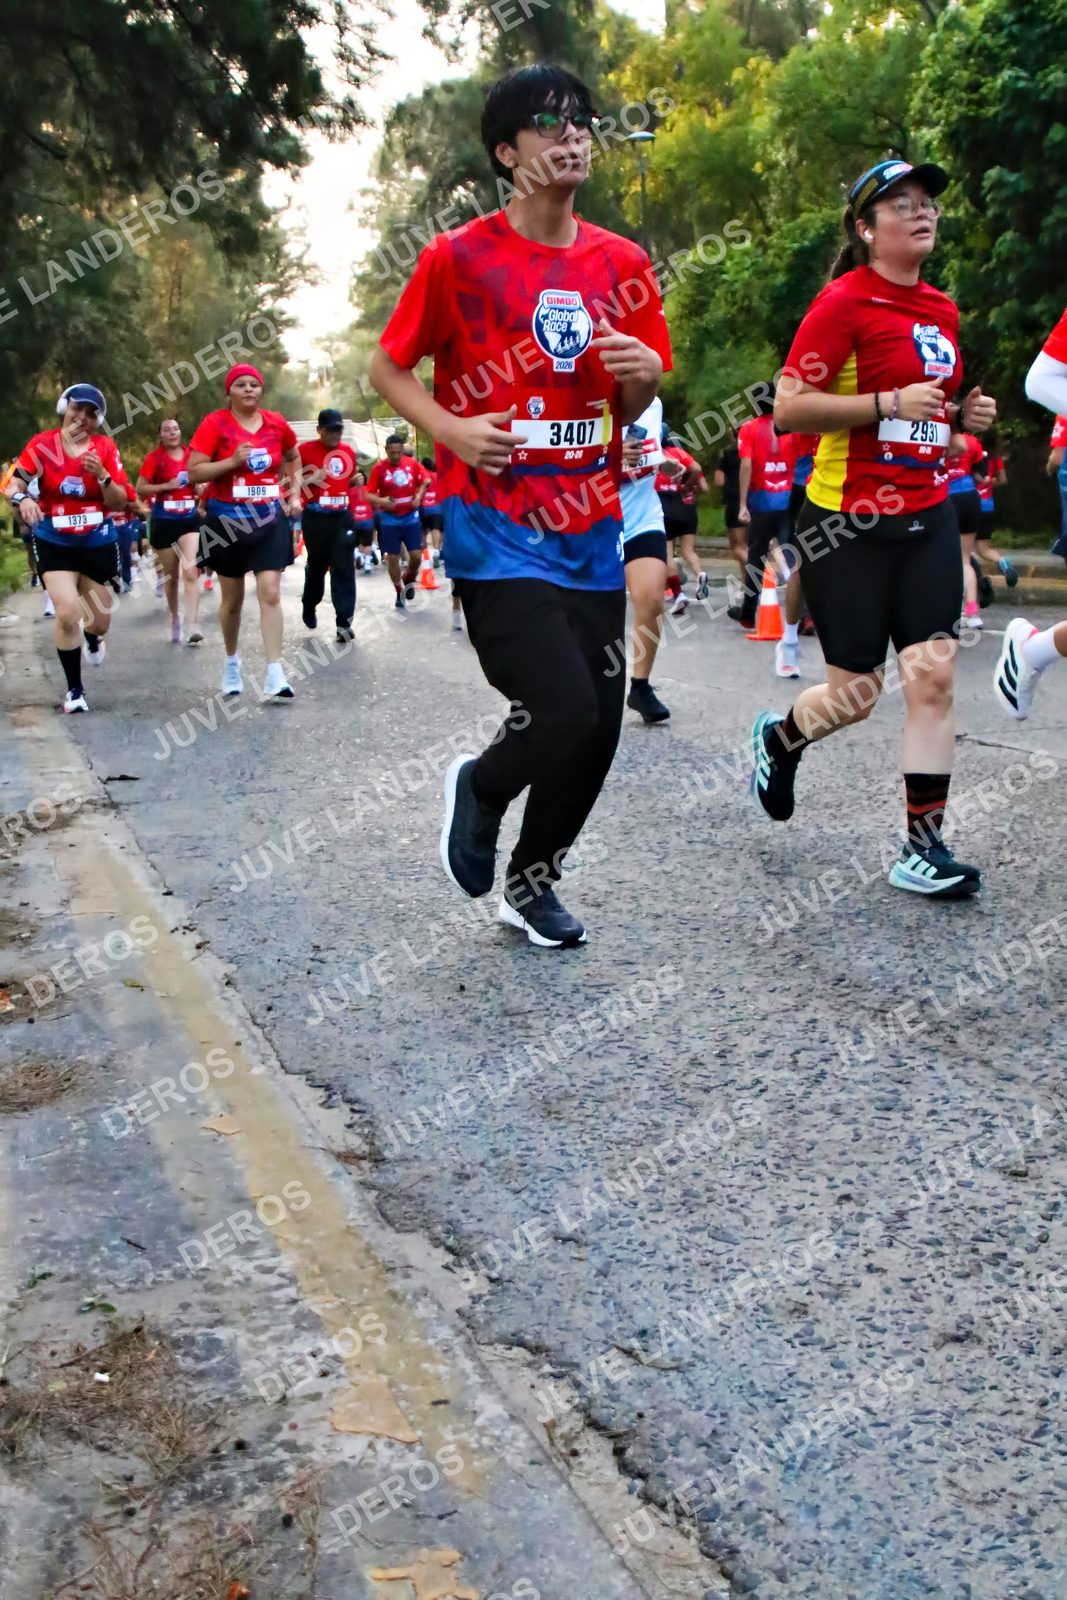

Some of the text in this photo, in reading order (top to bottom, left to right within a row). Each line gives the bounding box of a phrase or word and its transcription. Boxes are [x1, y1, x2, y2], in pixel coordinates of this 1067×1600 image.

[546, 296, 578, 306] BIMBO
[548, 308, 579, 323] Global
[542, 319, 568, 333] Race
[555, 360, 574, 370] 2026
[549, 420, 595, 447] 3407
[910, 420, 938, 443] 2931
[247, 486, 267, 497] 1909
[68, 514, 88, 526] 1373
